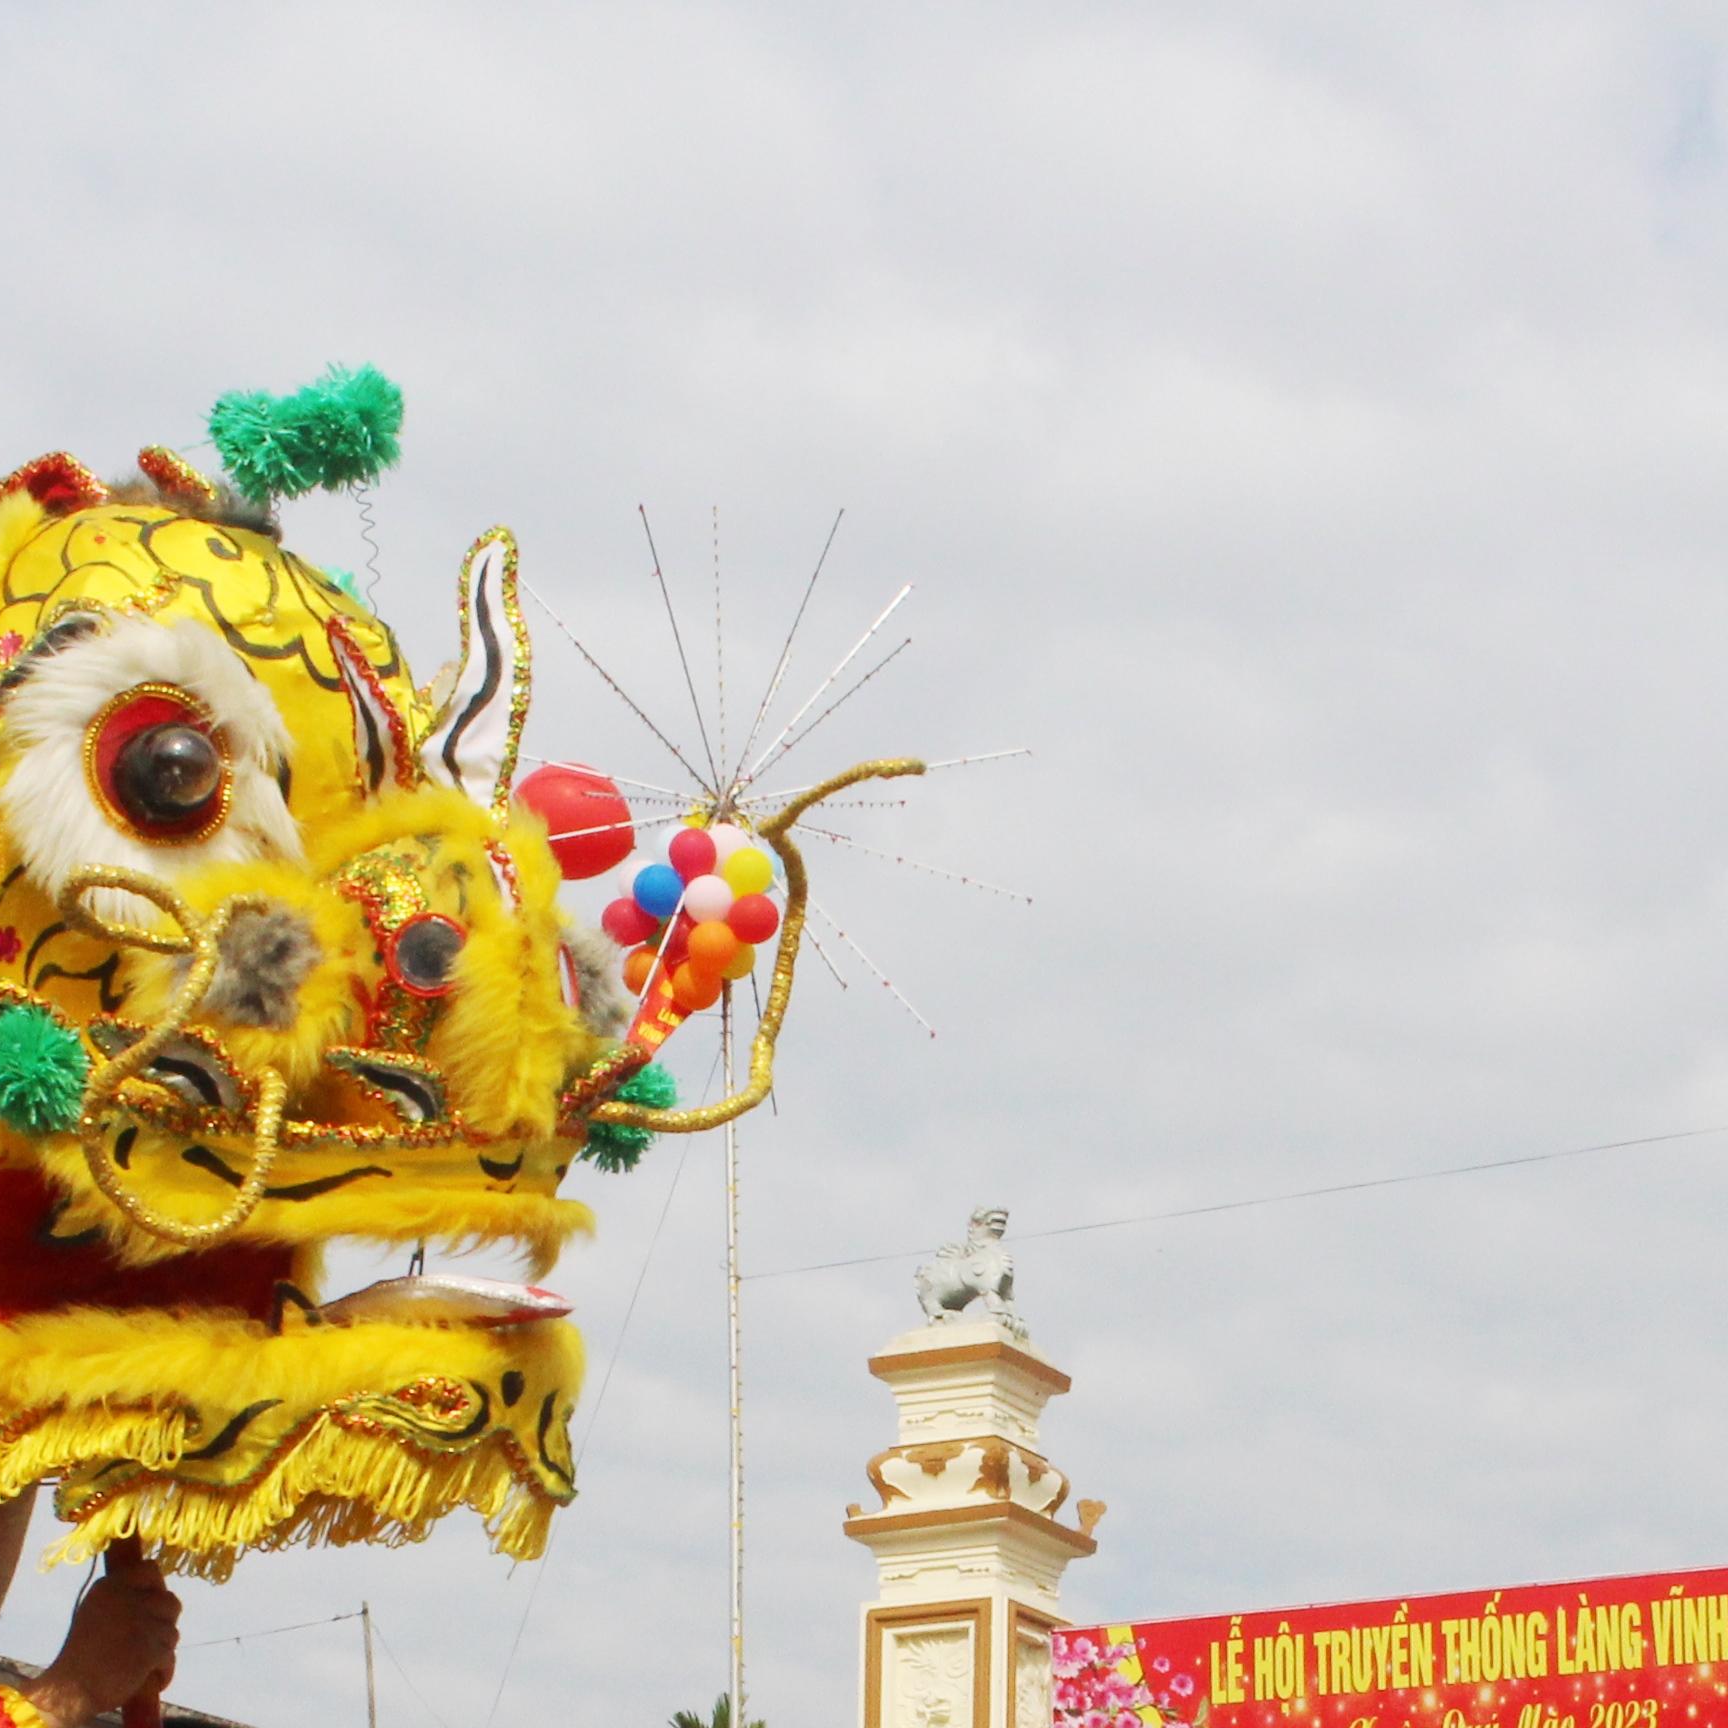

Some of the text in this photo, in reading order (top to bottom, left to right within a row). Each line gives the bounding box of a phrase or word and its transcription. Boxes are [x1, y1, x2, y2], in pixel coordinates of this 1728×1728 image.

[1210, 1615, 1246, 1705] LỄ
[1253, 1620, 1306, 1715] HỘI
[1313, 1601, 1434, 1696] TRUYỀN
[1440, 1591, 1548, 1685] THỐNG
[1556, 1593, 1644, 1676] LÀNG
